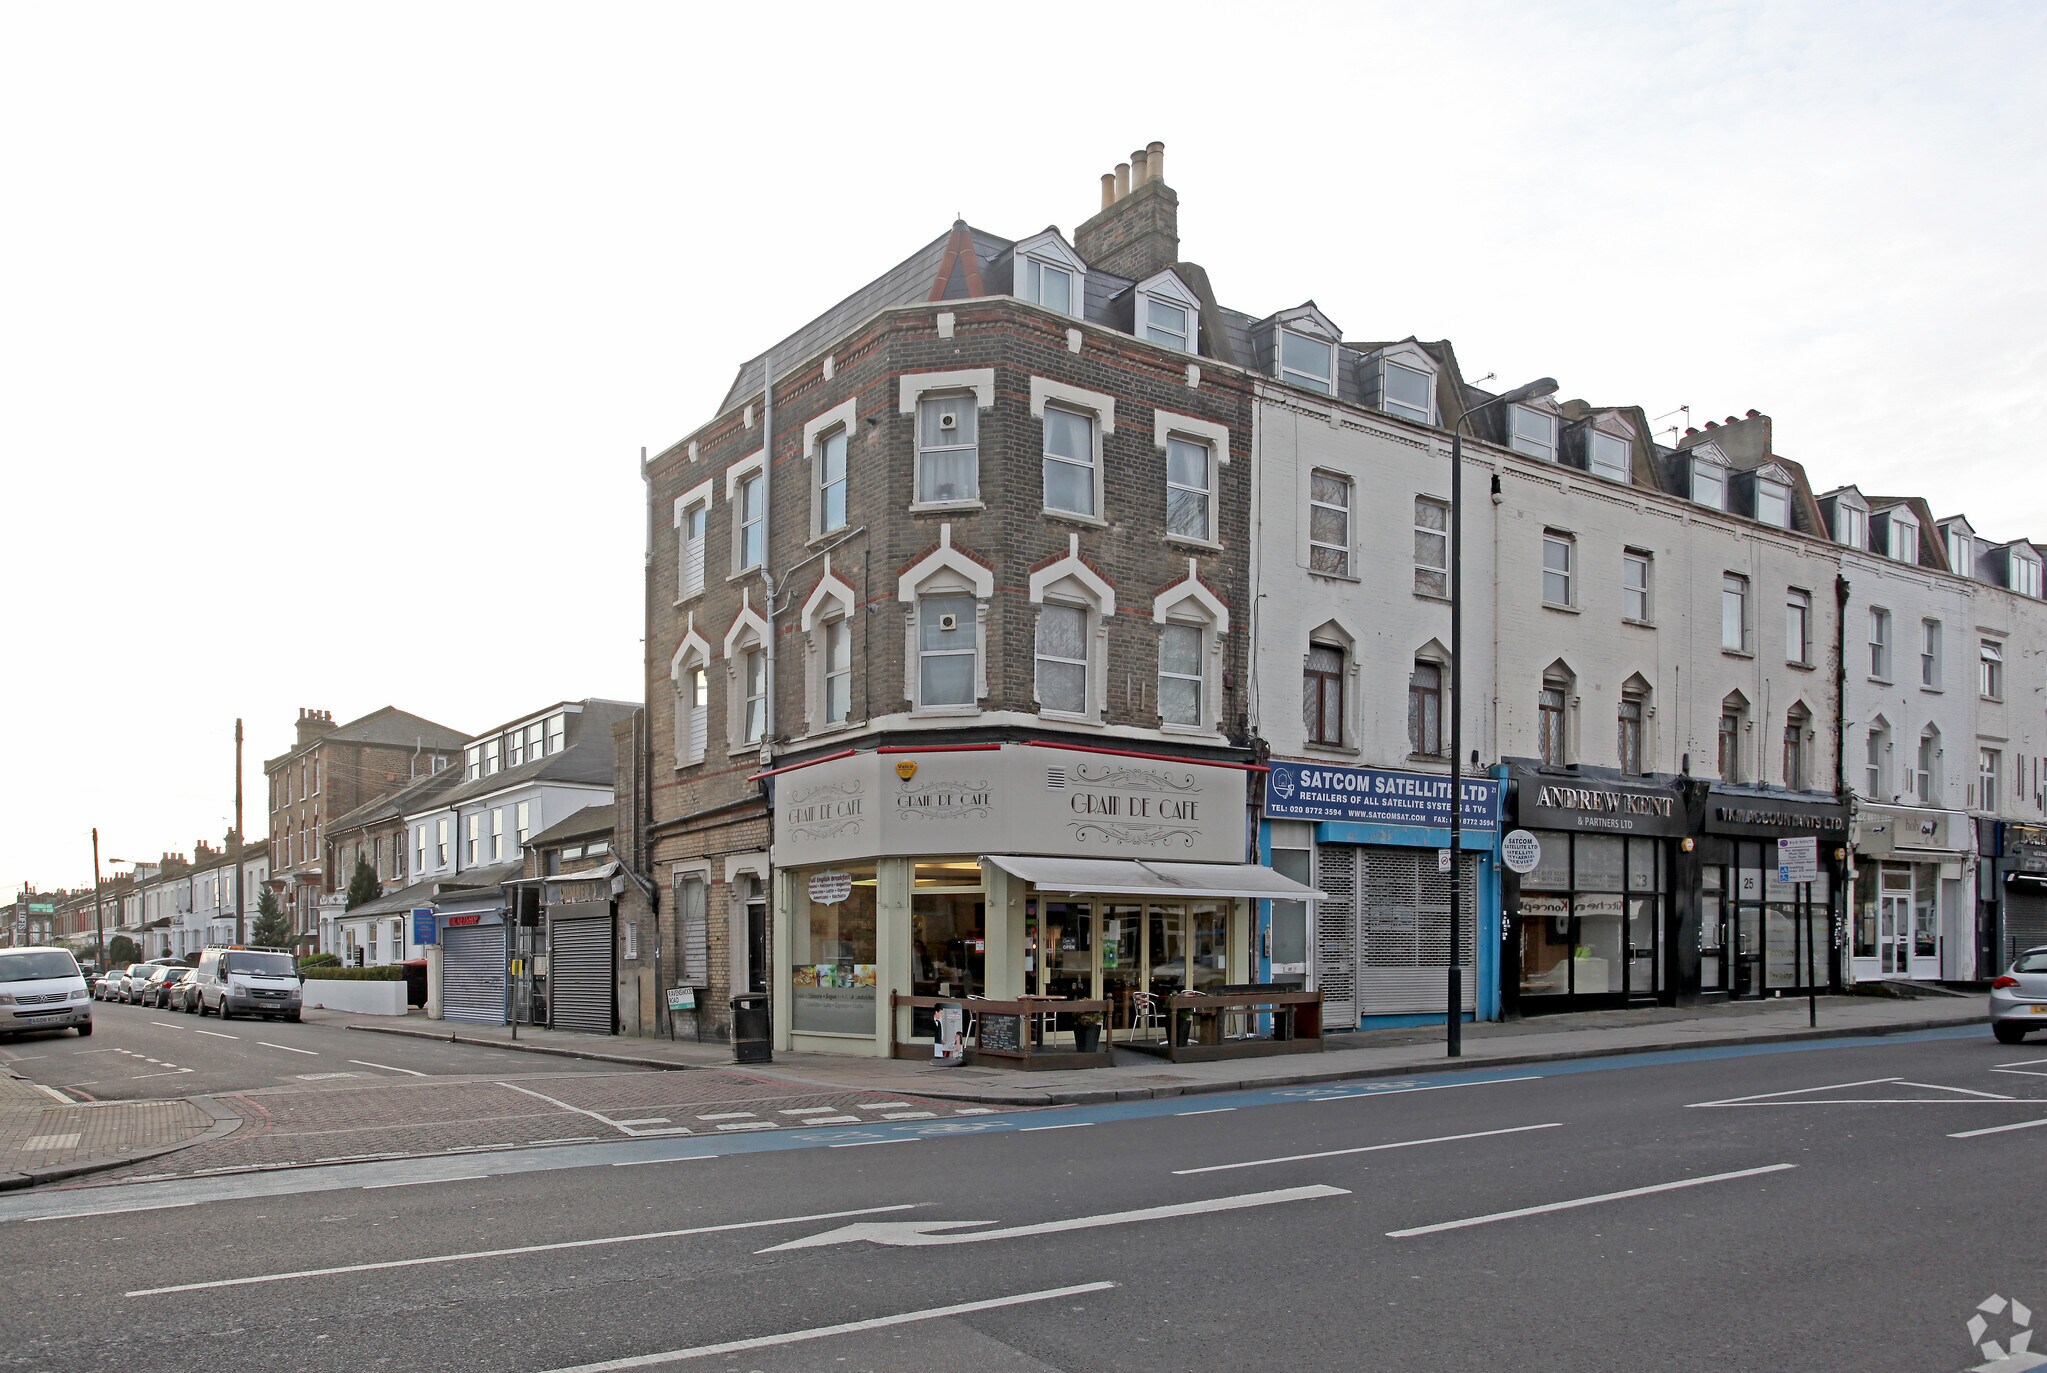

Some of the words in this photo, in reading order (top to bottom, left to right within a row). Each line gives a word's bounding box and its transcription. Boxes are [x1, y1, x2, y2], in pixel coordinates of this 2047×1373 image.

[1300, 769, 1369, 792] SATCOM
[1375, 776, 1451, 799] SATELLITE
[1460, 785, 1488, 801] LTD
[897, 795, 932, 807] GRAIN
[938, 794, 950, 806] DE
[960, 793, 991, 805] CAFE
[1071, 793, 1121, 815] GRAIN
[1129, 797, 1150, 817] DE
[1159, 799, 1199, 821] CAFE
[1300, 792, 1348, 803] RETAILERS
[1351, 795, 1361, 804] OF
[1364, 797, 1379, 806] ALL
[1382, 798, 1424, 809] SATELLITE
[1426, 801, 1462, 813] SYSTES
[1473, 805, 1487, 813] TVs
[1536, 785, 1620, 813] ANDREW
[1623, 793, 1674, 818] KENT
[788, 805, 815, 824] GRAIN
[820, 804, 832, 820] DE
[837, 799, 863, 816] CAFE
[1271, 804, 1287, 812] TEL:
[1290, 805, 1303, 813] 020
[1325, 808, 1342, 816] 3594
[1348, 809, 1426, 821] WWW.SATCOMSAT.COM
[1745, 810, 1821, 829] ACCOUNTANTS
[1578, 816, 1583, 825] &
[1585, 818, 1619, 828] PARTNERS
[1620, 820, 1633, 829] LTD
[1636, 874, 1647, 887] 23
[1744, 878, 1754, 889] 25
